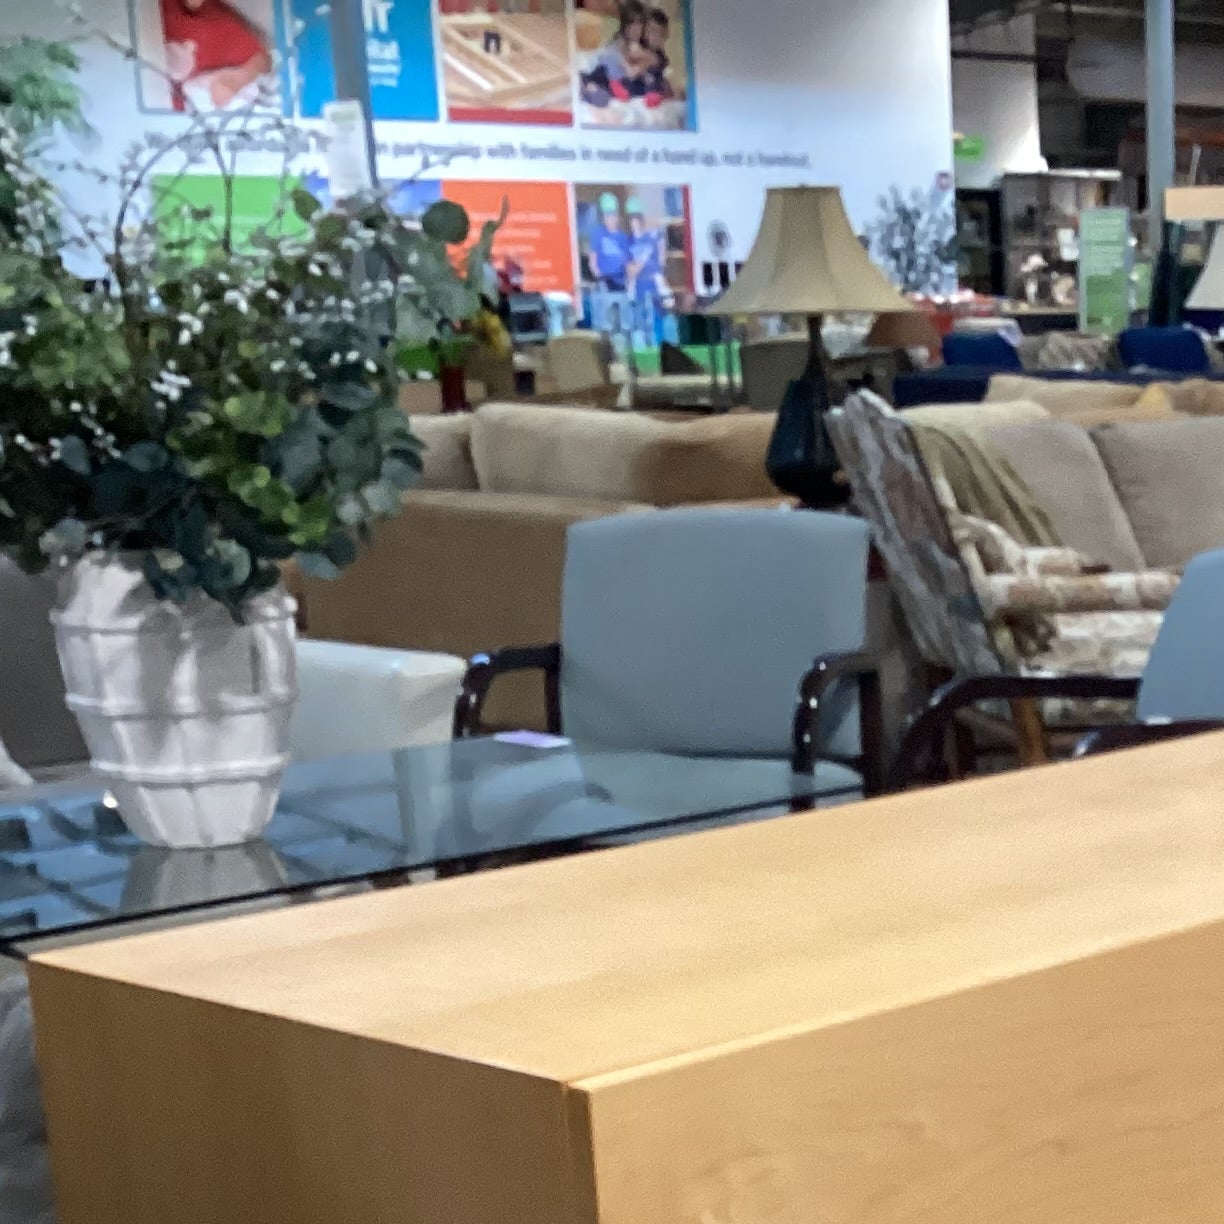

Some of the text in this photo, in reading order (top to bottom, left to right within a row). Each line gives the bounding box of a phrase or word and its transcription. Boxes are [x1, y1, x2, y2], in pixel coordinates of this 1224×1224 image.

[520, 143, 577, 160] families
[597, 146, 631, 162] need
[661, 148, 695, 164] hand
